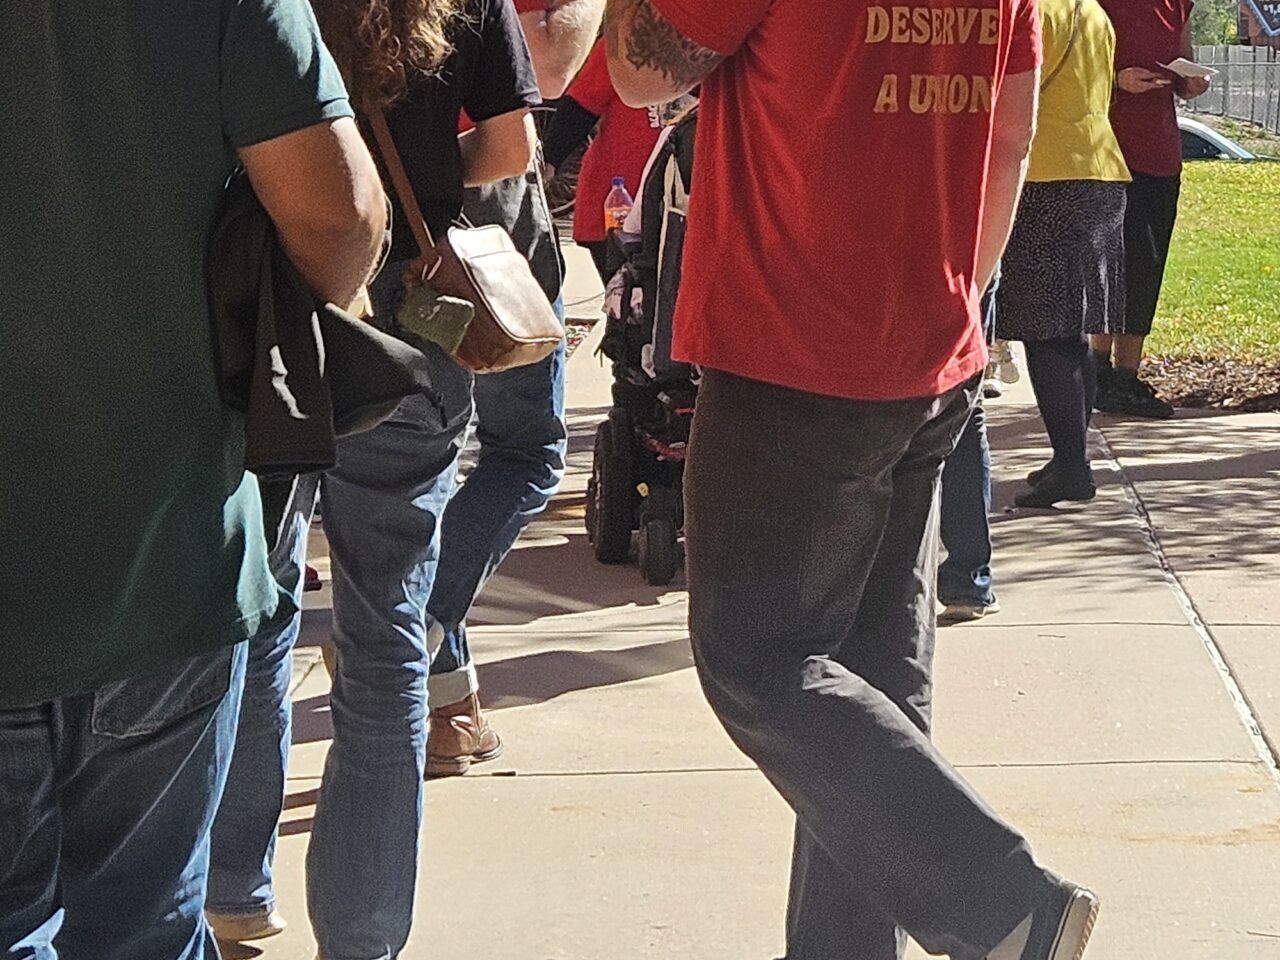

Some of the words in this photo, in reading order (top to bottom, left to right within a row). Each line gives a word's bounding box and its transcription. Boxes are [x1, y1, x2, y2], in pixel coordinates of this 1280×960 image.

[864, 6, 999, 44] DESERVE
[873, 74, 899, 113] A
[908, 74, 995, 114] UNION
